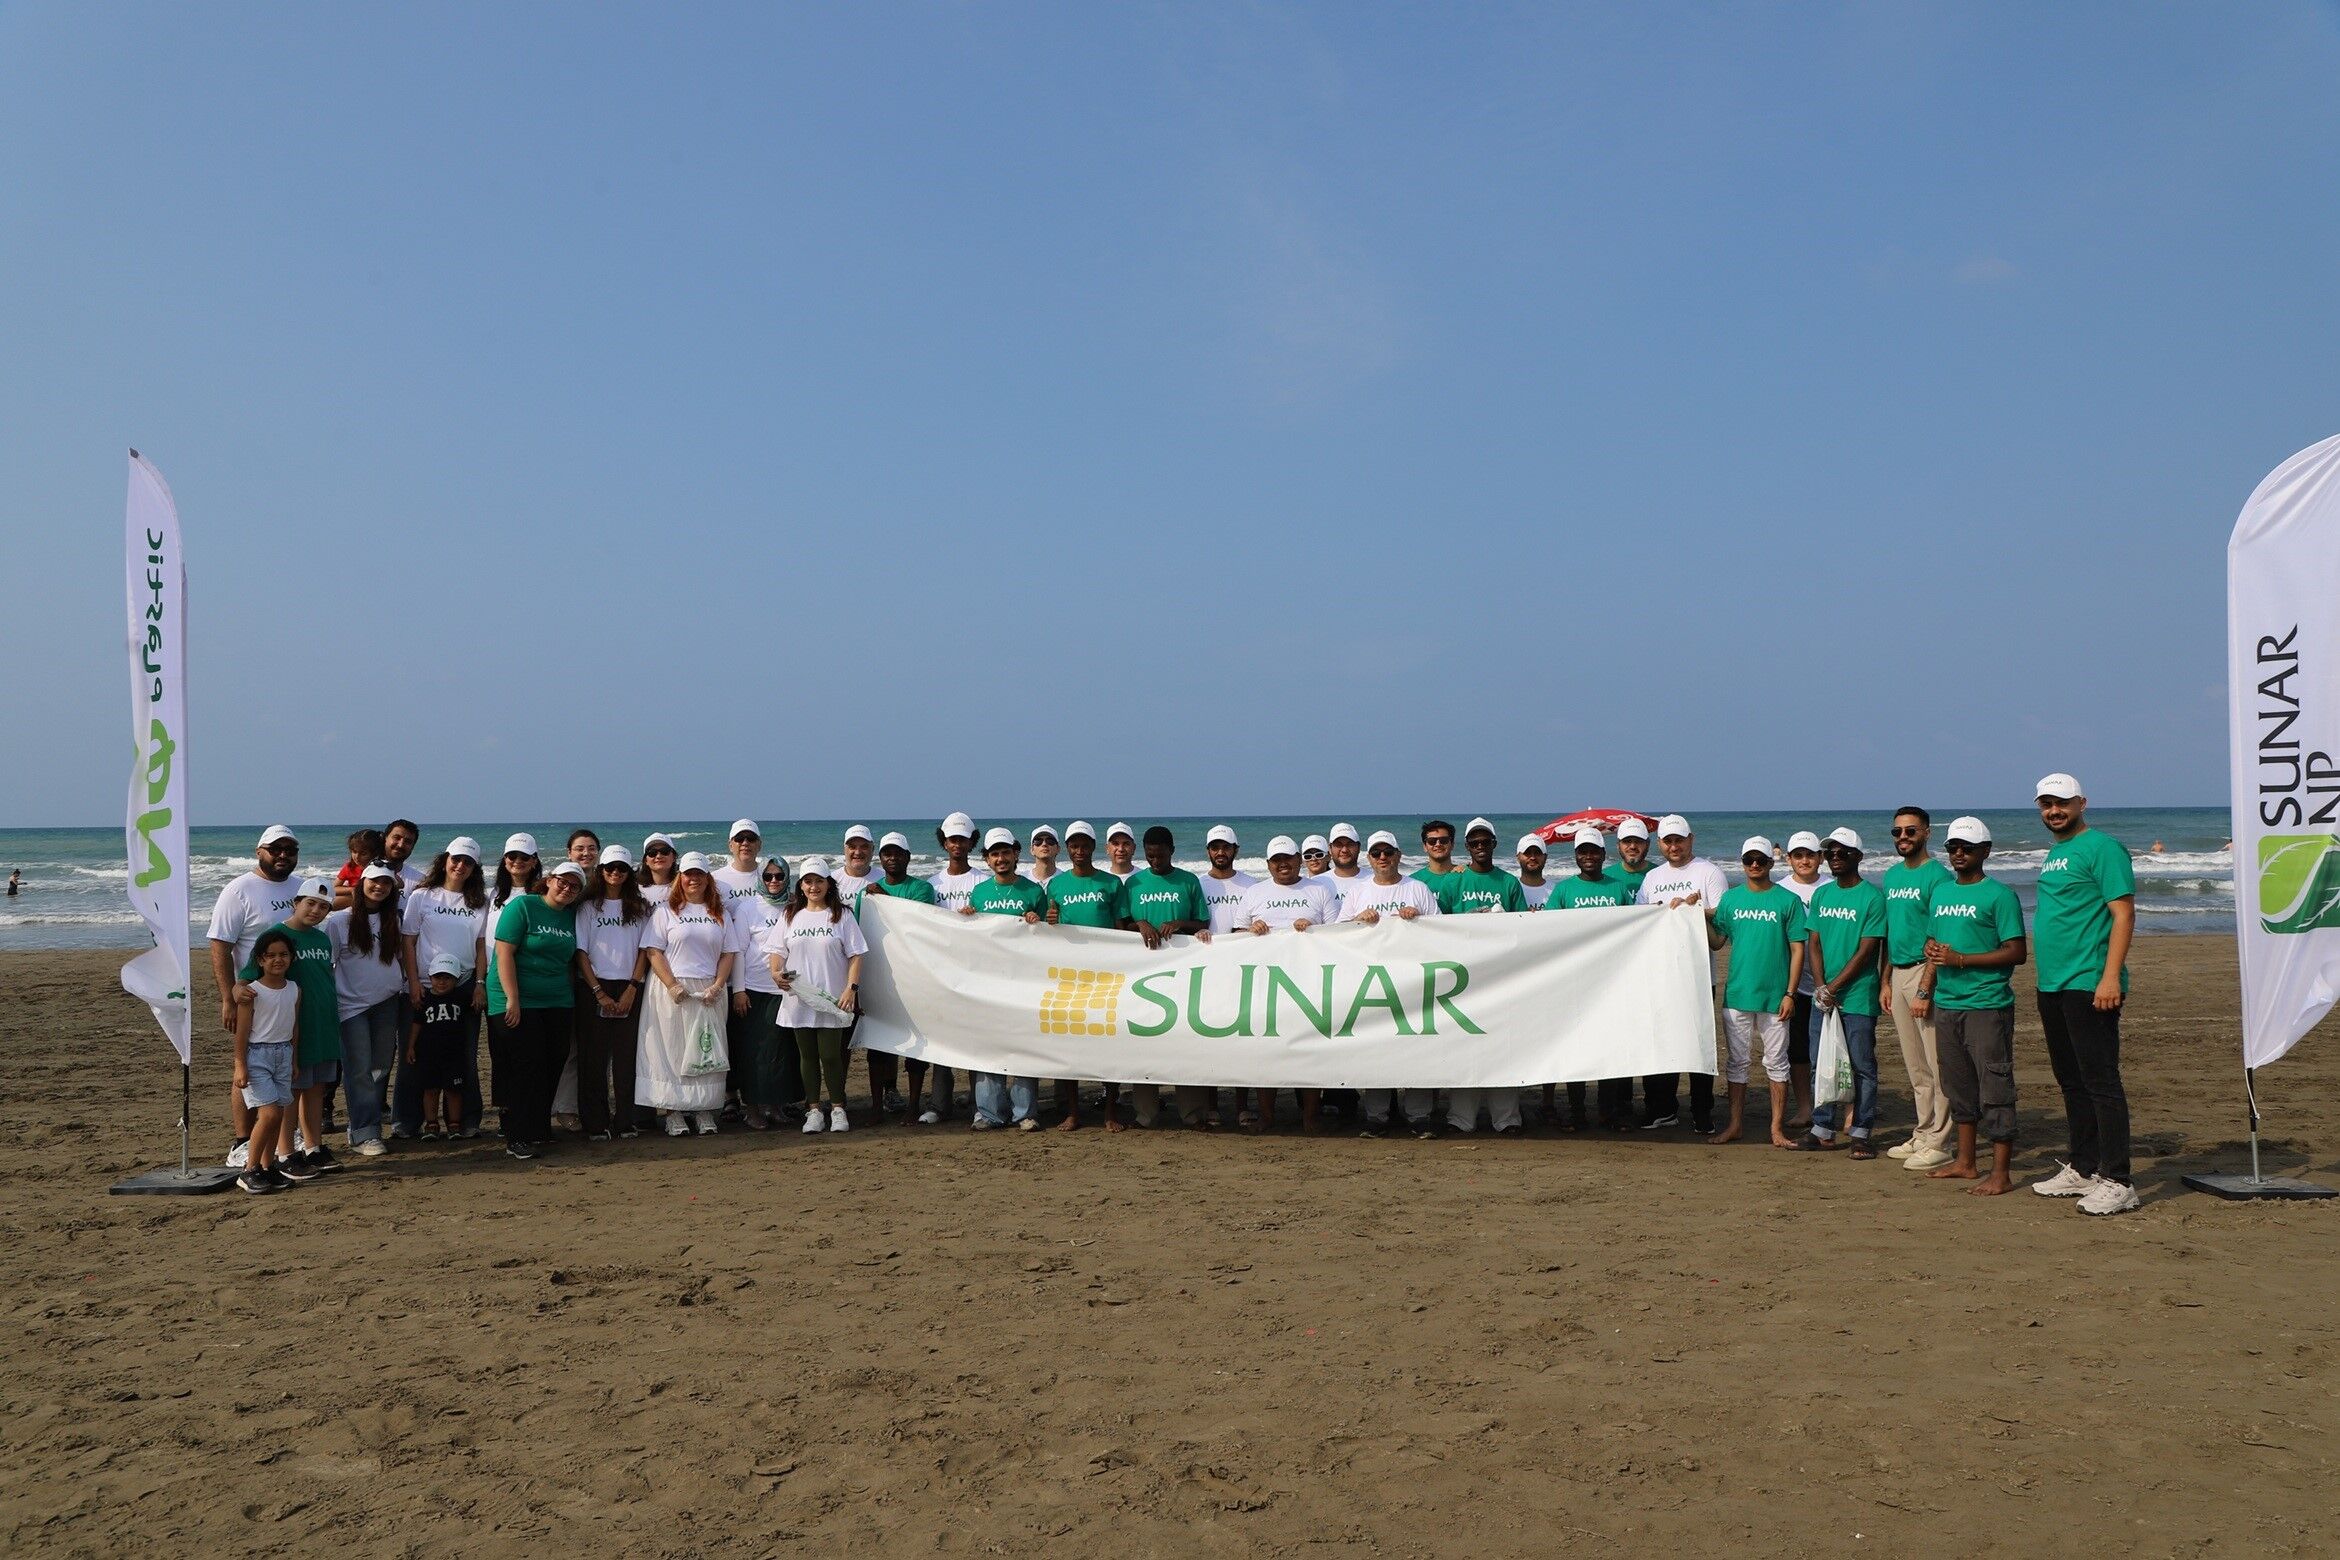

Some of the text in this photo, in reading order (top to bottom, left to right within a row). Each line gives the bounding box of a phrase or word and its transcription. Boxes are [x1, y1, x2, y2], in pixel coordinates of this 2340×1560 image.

[2256, 622, 2302, 827] SUNAR
[1653, 880, 1693, 894] SUNAR
[1886, 887, 1921, 901] SUNAR
[1063, 891, 1105, 906] SUNAR
[1140, 891, 1181, 905] SUNAR
[1207, 894, 1243, 906] SUNA
[1266, 898, 1310, 910] SUNAR
[1462, 890, 1502, 905] SUNAR
[1574, 895, 1617, 907] SUNAR
[271, 899, 295, 911] SUN
[434, 906, 476, 918] UNAR
[983, 898, 1025, 912] SUNAR
[1934, 904, 1977, 919] SUNAR
[1732, 908, 1778, 923] SUNAR
[1818, 905, 1857, 922] SUNAR
[793, 926, 834, 939] SUNAR
[1126, 960, 1488, 1039] SUNAR
[425, 1003, 462, 1024] GAP
